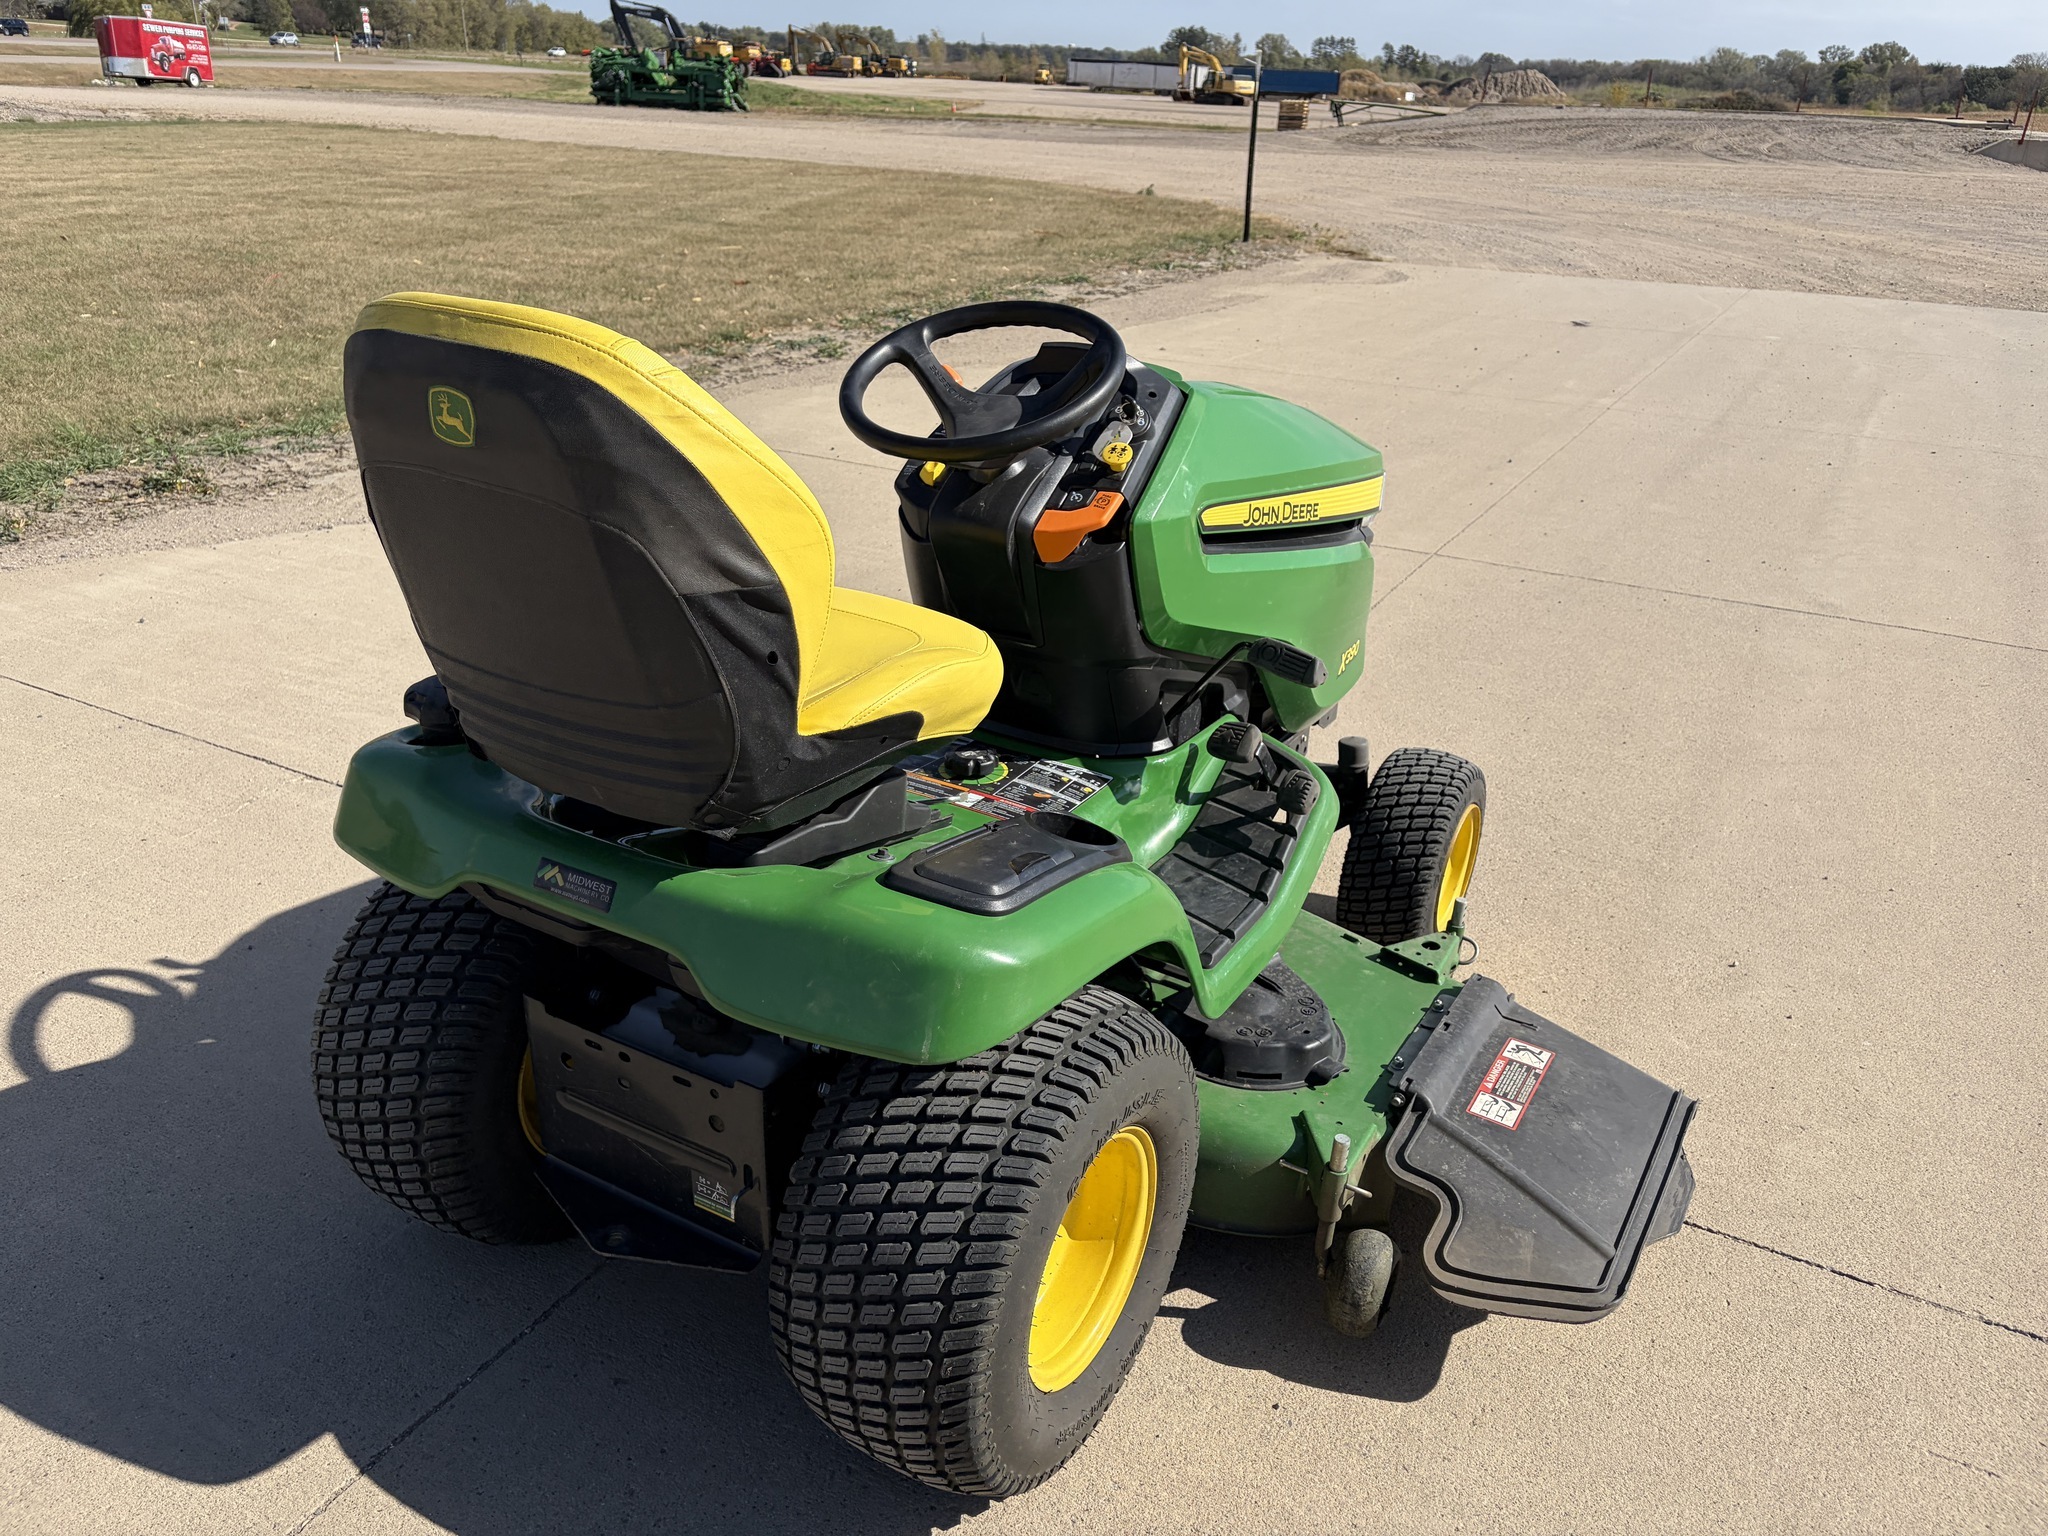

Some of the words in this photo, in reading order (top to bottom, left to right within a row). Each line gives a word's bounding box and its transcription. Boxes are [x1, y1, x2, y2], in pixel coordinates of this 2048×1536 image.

[142, 23, 163, 33] SEWER
[163, 25, 184, 35] PUMPING
[184, 28, 205, 38] SERVICES
[1243, 503, 1280, 524] JOHN
[1282, 501, 1320, 520] DEERE
[565, 882, 599, 899] MACHINERY
[567, 873, 613, 895] MIDWEST
[1487, 1060, 1506, 1081] DANGER
